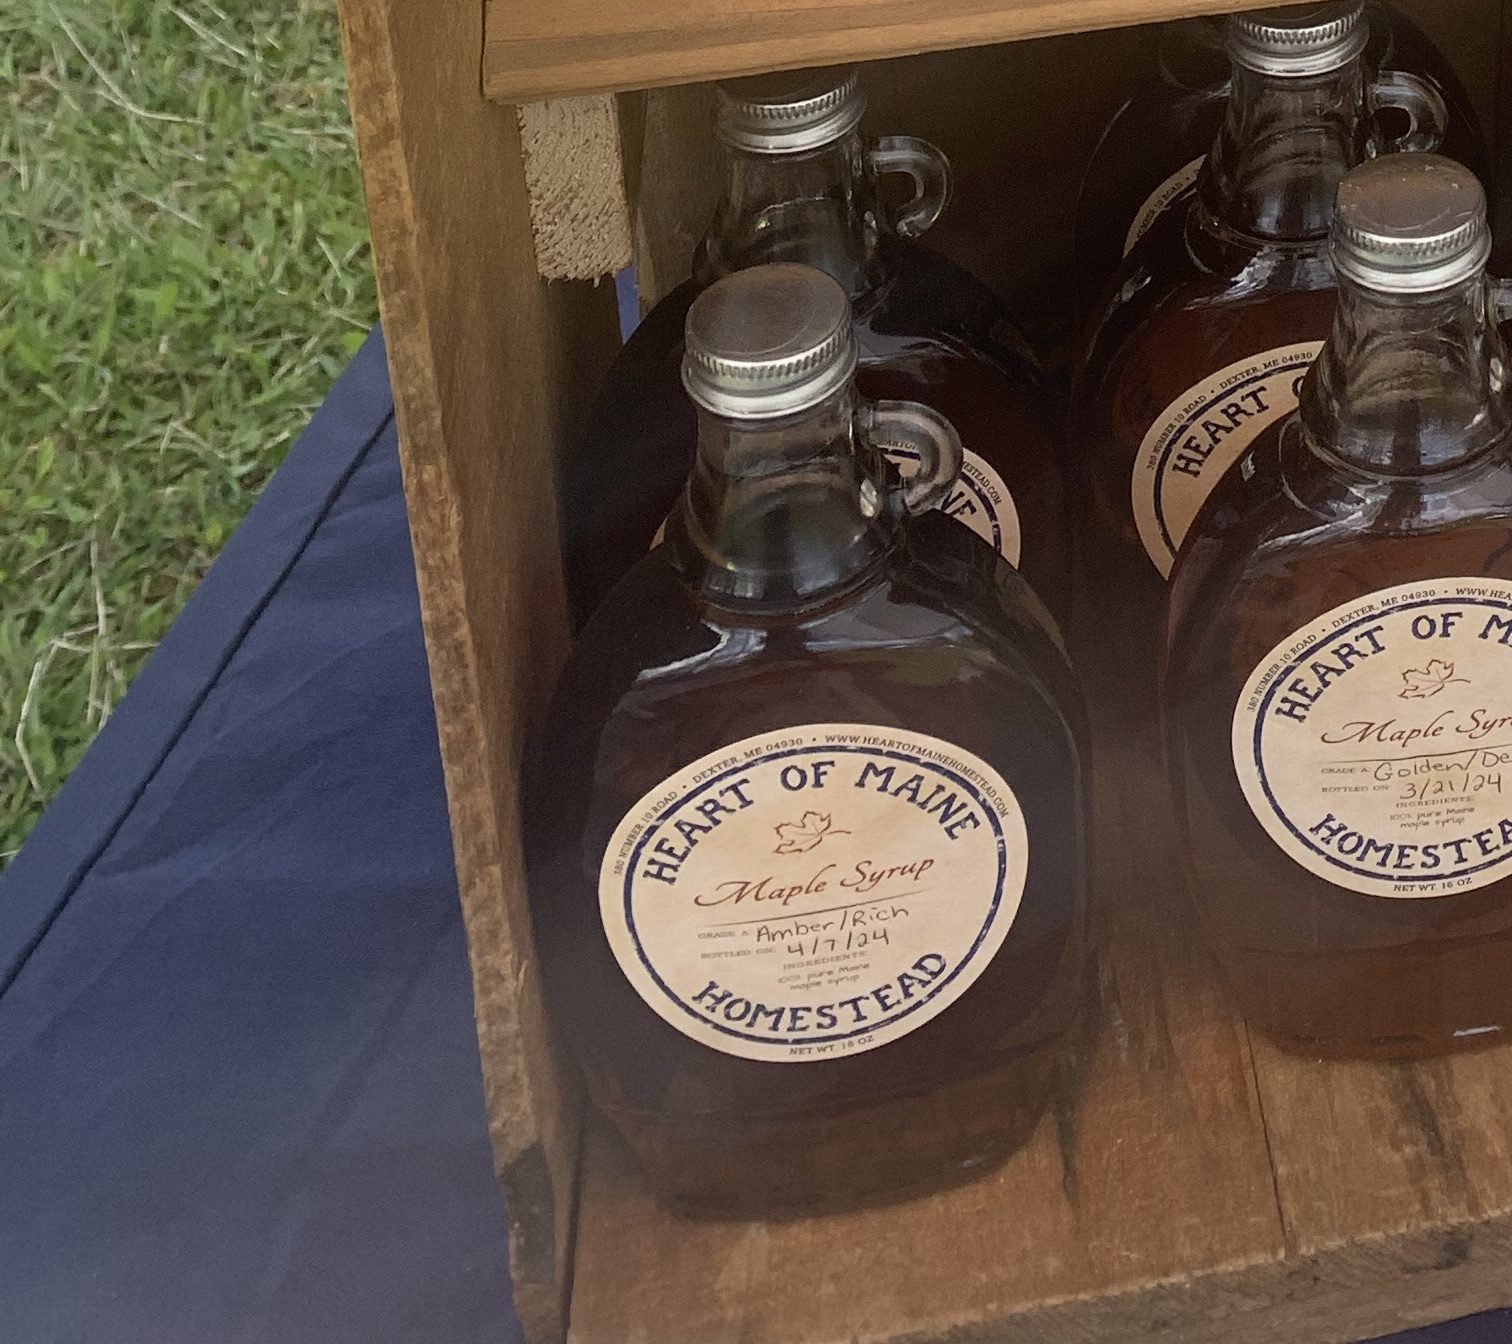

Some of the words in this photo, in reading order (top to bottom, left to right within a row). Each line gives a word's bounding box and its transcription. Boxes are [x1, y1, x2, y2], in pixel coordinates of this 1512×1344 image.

[1172, 386, 1270, 479] HEART
[1275, 625, 1385, 724] HEART
[1410, 612, 1463, 641] OF
[1320, 710, 1454, 748] Maple
[642, 778, 753, 887] HEART
[779, 760, 836, 792] OF
[854, 760, 980, 841] MAINE
[693, 863, 836, 907] Maple
[839, 859, 934, 893] Syrup
[692, 952, 946, 1033] HOMESTEAD
